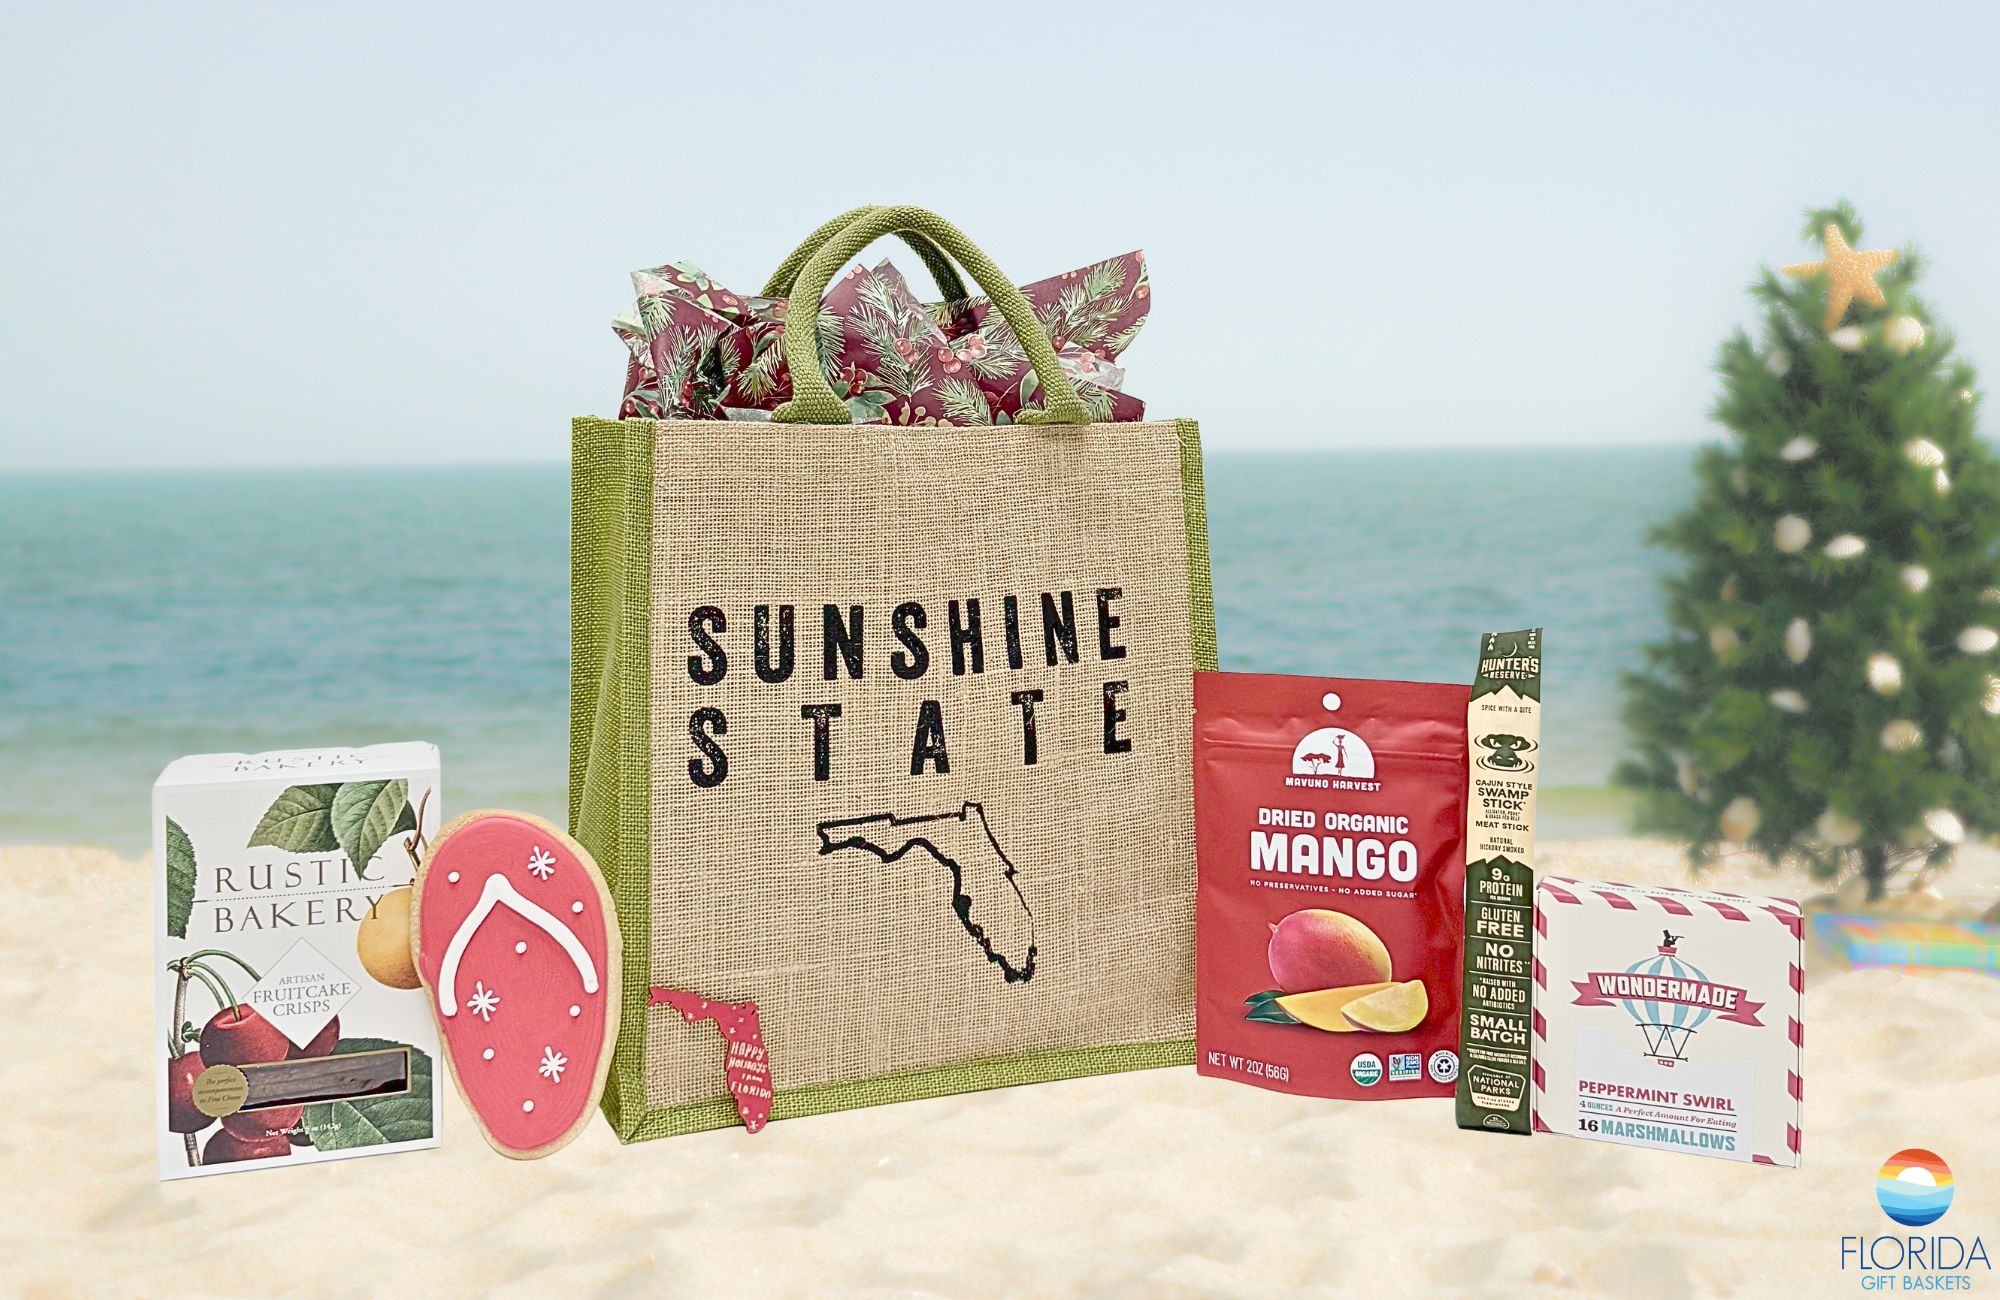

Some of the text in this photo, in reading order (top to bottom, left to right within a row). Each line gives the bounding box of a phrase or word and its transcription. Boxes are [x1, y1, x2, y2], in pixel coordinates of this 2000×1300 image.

[687, 587, 1127, 686] SUNSHINE
[1481, 656, 1539, 674] HUNTER'S
[1490, 671, 1526, 680] RESERVE
[1481, 704, 1497, 712] SPICE
[1498, 705, 1513, 713] WITH
[688, 680, 1132, 788] STATE
[1285, 776, 1381, 792] MAVUNO HARVEST
[1475, 779, 1533, 790] CAJUN STYLE
[1478, 787, 1529, 800] SWAMP
[1258, 807, 1409, 834] DRIED ORGANIC
[1502, 823, 1529, 831] STICK
[1480, 843, 1524, 854] HICKORY SMOKED
[1490, 837, 1513, 845] NATURAL
[1250, 830, 1418, 882] MANGO
[215, 855, 386, 894] RUSTIC
[1250, 879, 1261, 887] NO
[1264, 881, 1329, 893] PRESERVATIVES
[1354, 888, 1383, 897] ADDED
[1479, 880, 1523, 897] PROTEIN
[214, 894, 384, 933] BAKERY
[1481, 906, 1520, 923] GLUTEN
[1476, 920, 1524, 938] FREE
[1485, 942, 1514, 958] NO
[278, 972, 326, 986] ARTISAN
[1501, 979, 1516, 988] WITH
[252, 982, 352, 1004] FRUITCAKE
[1472, 984, 1526, 1003] NO ADDED
[1596, 974, 1740, 1011] WONDERMADE
[272, 999, 330, 1016] CRISPS
[1482, 1000, 1515, 1010] ANTIBIOTICS
[1470, 1013, 1527, 1032] SMALL
[1470, 1026, 1526, 1045] BATCH
[730, 1041, 765, 1061] HAPPY
[728, 1057, 768, 1073] HOLIDAYS
[1208, 1051, 1226, 1067] NET
[1229, 1055, 1244, 1070] WT
[1265, 1062, 1289, 1083] (56G)
[1357, 1060, 1376, 1068] USDA
[731, 1081, 772, 1099] FLORIDA
[1473, 1075, 1519, 1088] NATIONAL
[1481, 1084, 1511, 1095] PARKS
[1579, 1080, 1735, 1111] PEPPERMINT SWIRL
[1579, 1100, 1586, 1108] 4
[1587, 1100, 1613, 1111] OUNCES
[1623, 1106, 1653, 1117] Perfect
[1654, 1111, 1689, 1122] Amount
[1690, 1116, 1706, 1124] For
[1706, 1118, 1737, 1128] Eating
[280, 1127, 304, 1135] Weight
[1578, 1118, 1736, 1152] 16 MARSHMALLOWS
